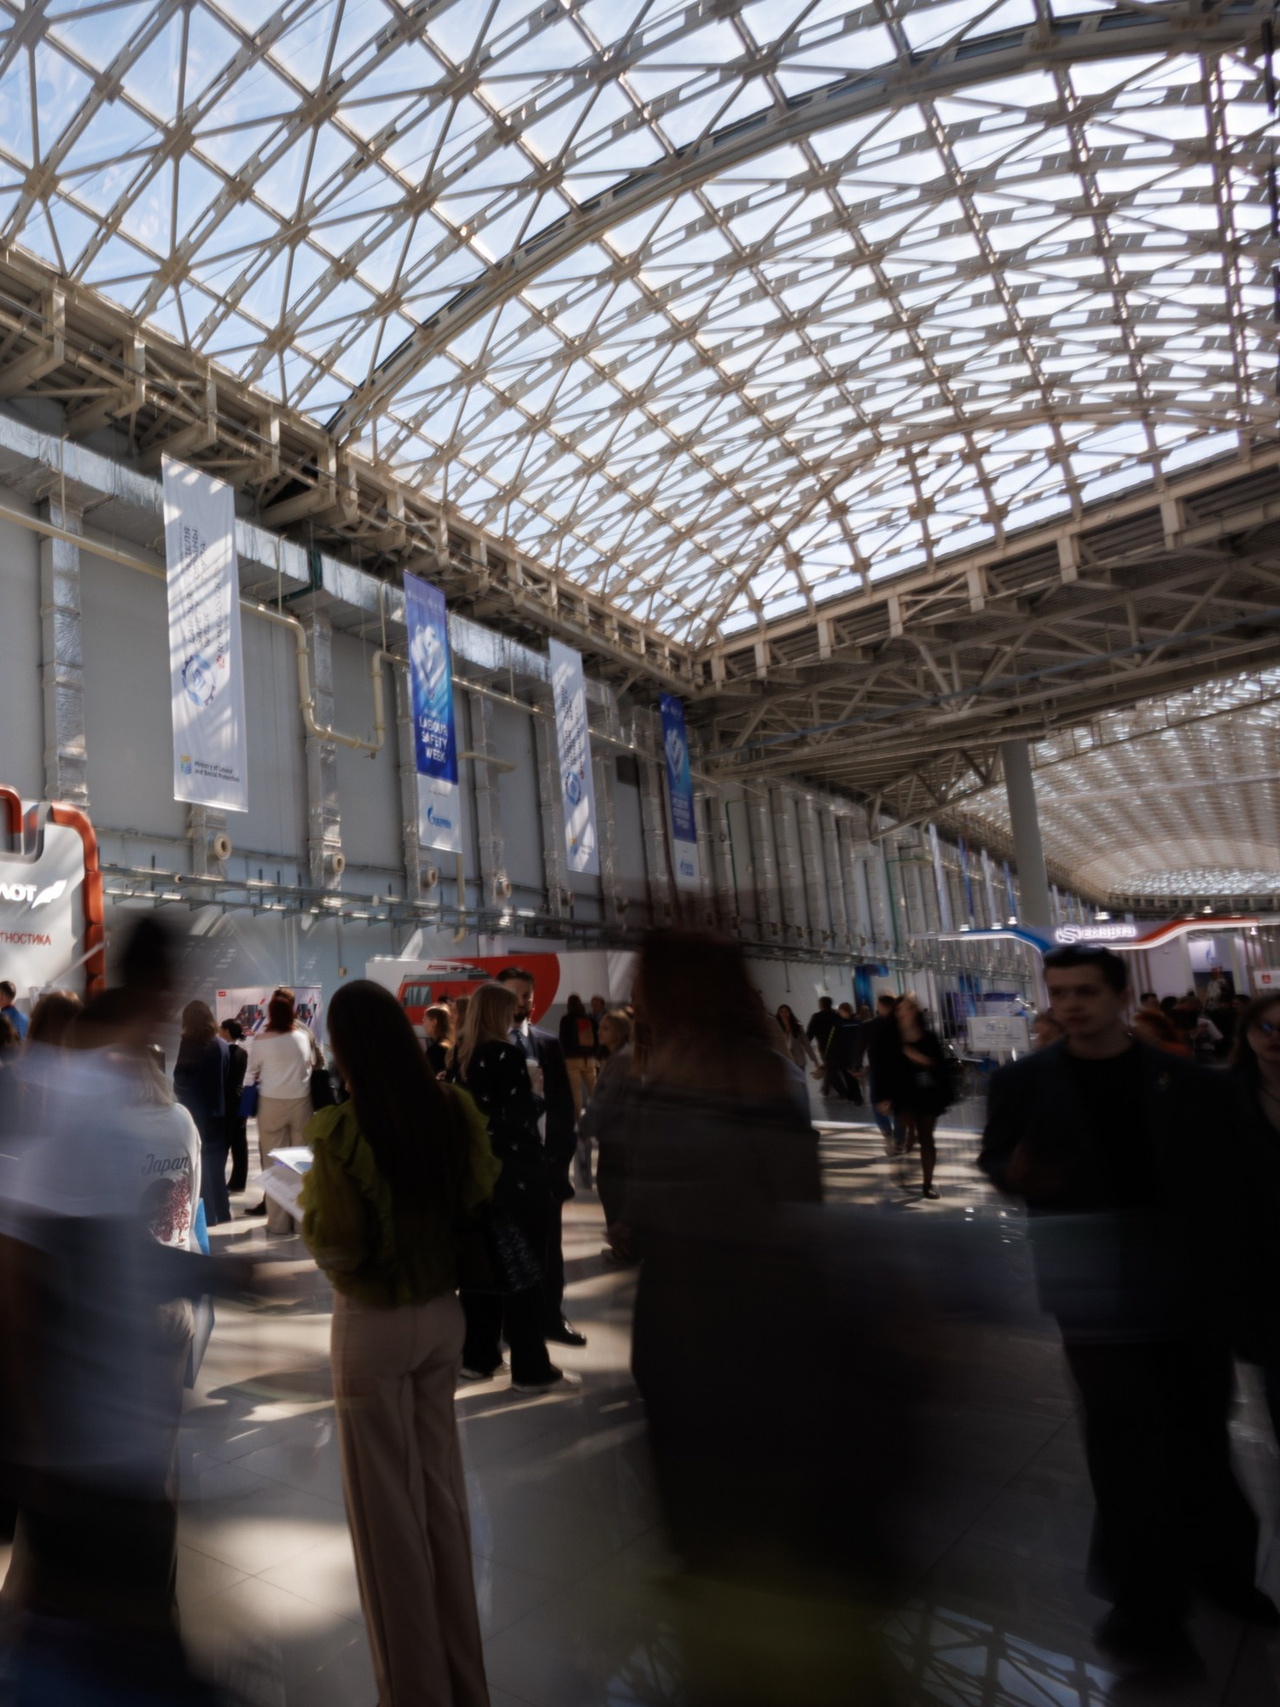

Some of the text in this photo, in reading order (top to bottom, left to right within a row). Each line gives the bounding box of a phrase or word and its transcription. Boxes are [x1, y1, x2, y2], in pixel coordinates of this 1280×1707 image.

[419, 716, 448, 737] LABOUR
[421, 730, 447, 751] SAFETY
[425, 747, 446, 763] WEEK
[141, 1153, 188, 1176] Japan
